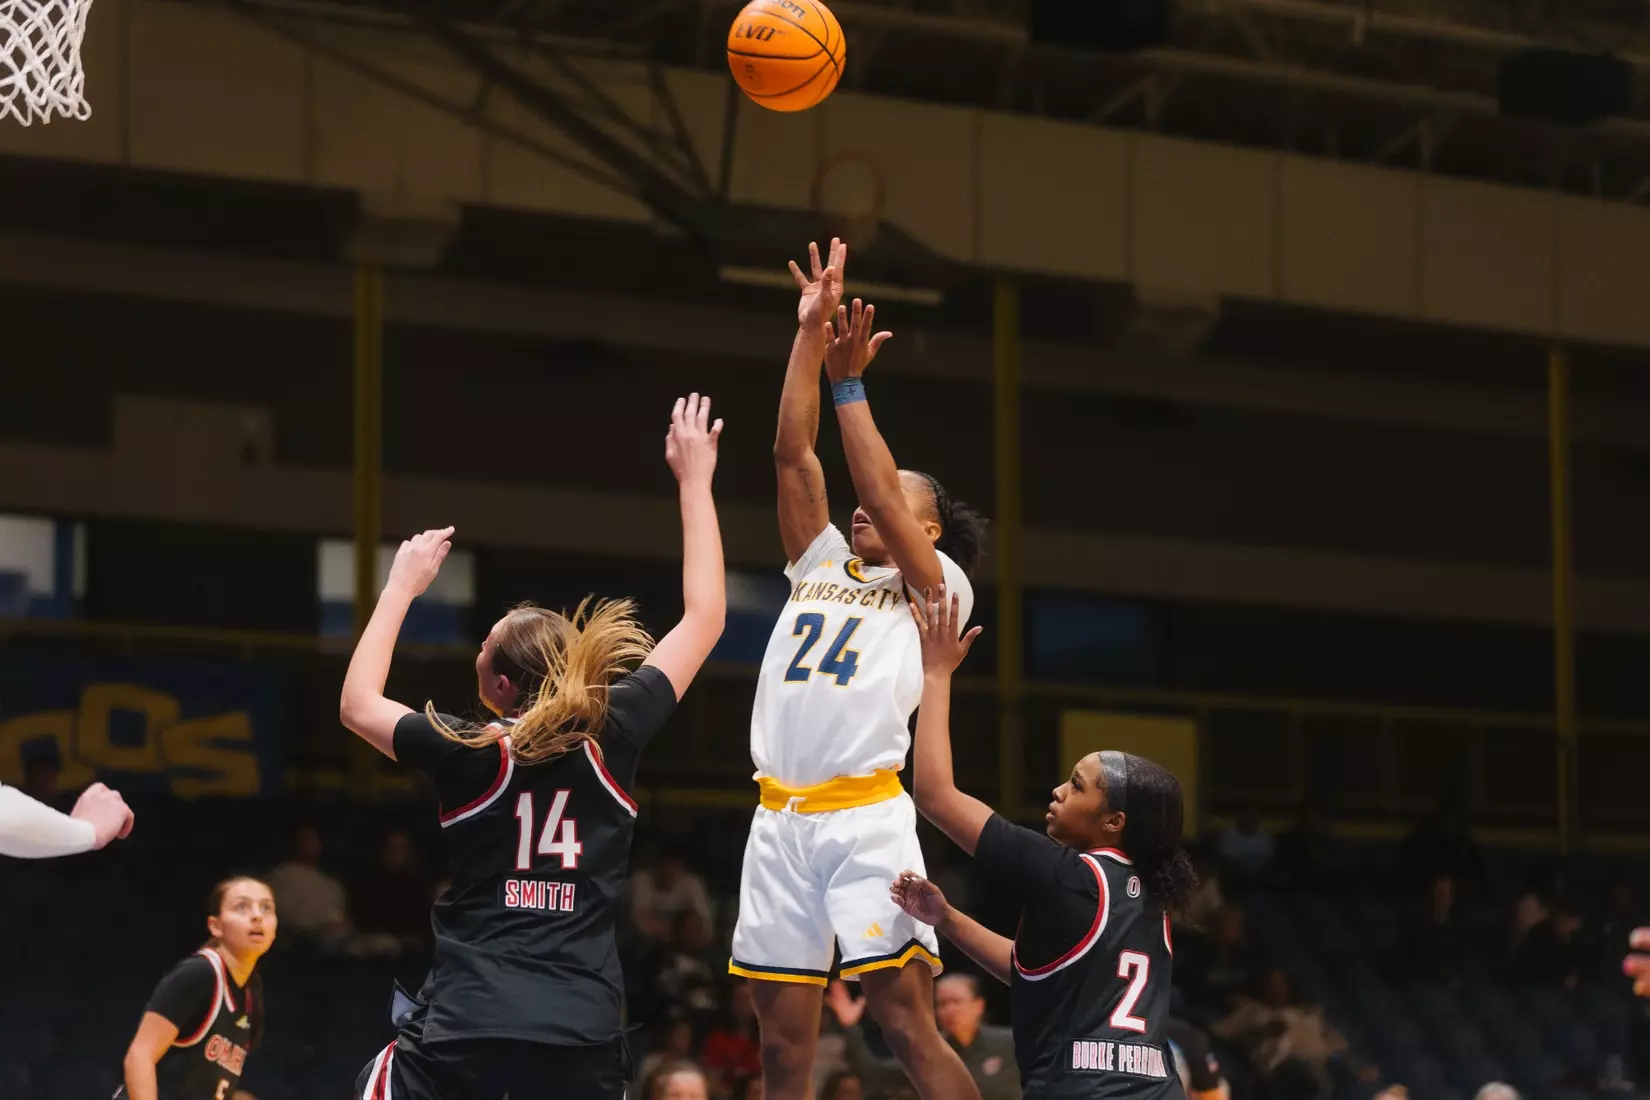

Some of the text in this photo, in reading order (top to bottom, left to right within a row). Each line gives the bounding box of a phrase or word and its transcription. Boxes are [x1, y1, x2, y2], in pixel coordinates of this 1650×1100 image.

[790, 581, 861, 605] KANSAS
[784, 611, 864, 688] 24
[513, 788, 583, 872] 14
[505, 879, 576, 912] SMITH
[1109, 949, 1151, 1034] 2
[1072, 1040, 1115, 1071] BURKE
